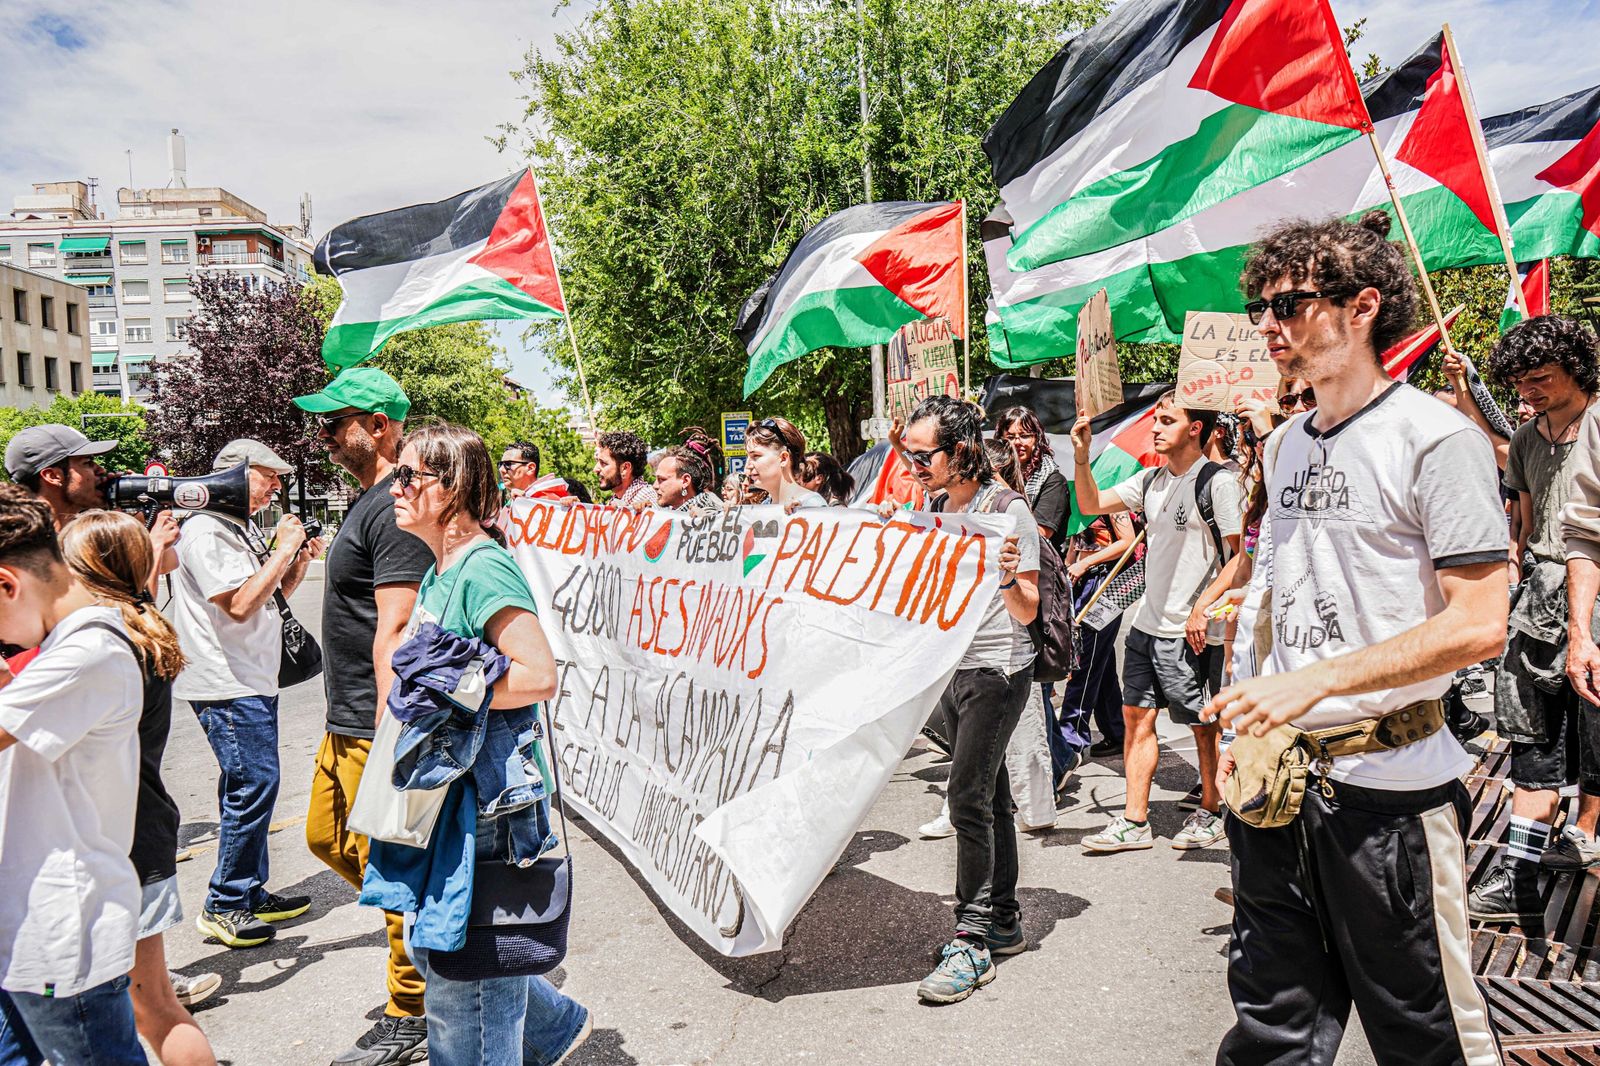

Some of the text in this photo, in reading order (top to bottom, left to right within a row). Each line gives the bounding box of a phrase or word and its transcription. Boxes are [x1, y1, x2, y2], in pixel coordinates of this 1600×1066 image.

[916, 320, 950, 344] LUCHA
[1190, 321, 1266, 341] LA LUC
[922, 343, 957, 369] PUEBLO
[1215, 348, 1270, 362] ES EL
[509, 503, 655, 560] SOLIDARIDAD
[721, 505, 743, 535] EL
[676, 530, 739, 563] PUEBLO
[626, 572, 783, 679] ASESINADXS
[585, 665, 609, 738] A
[615, 671, 642, 754] LA
